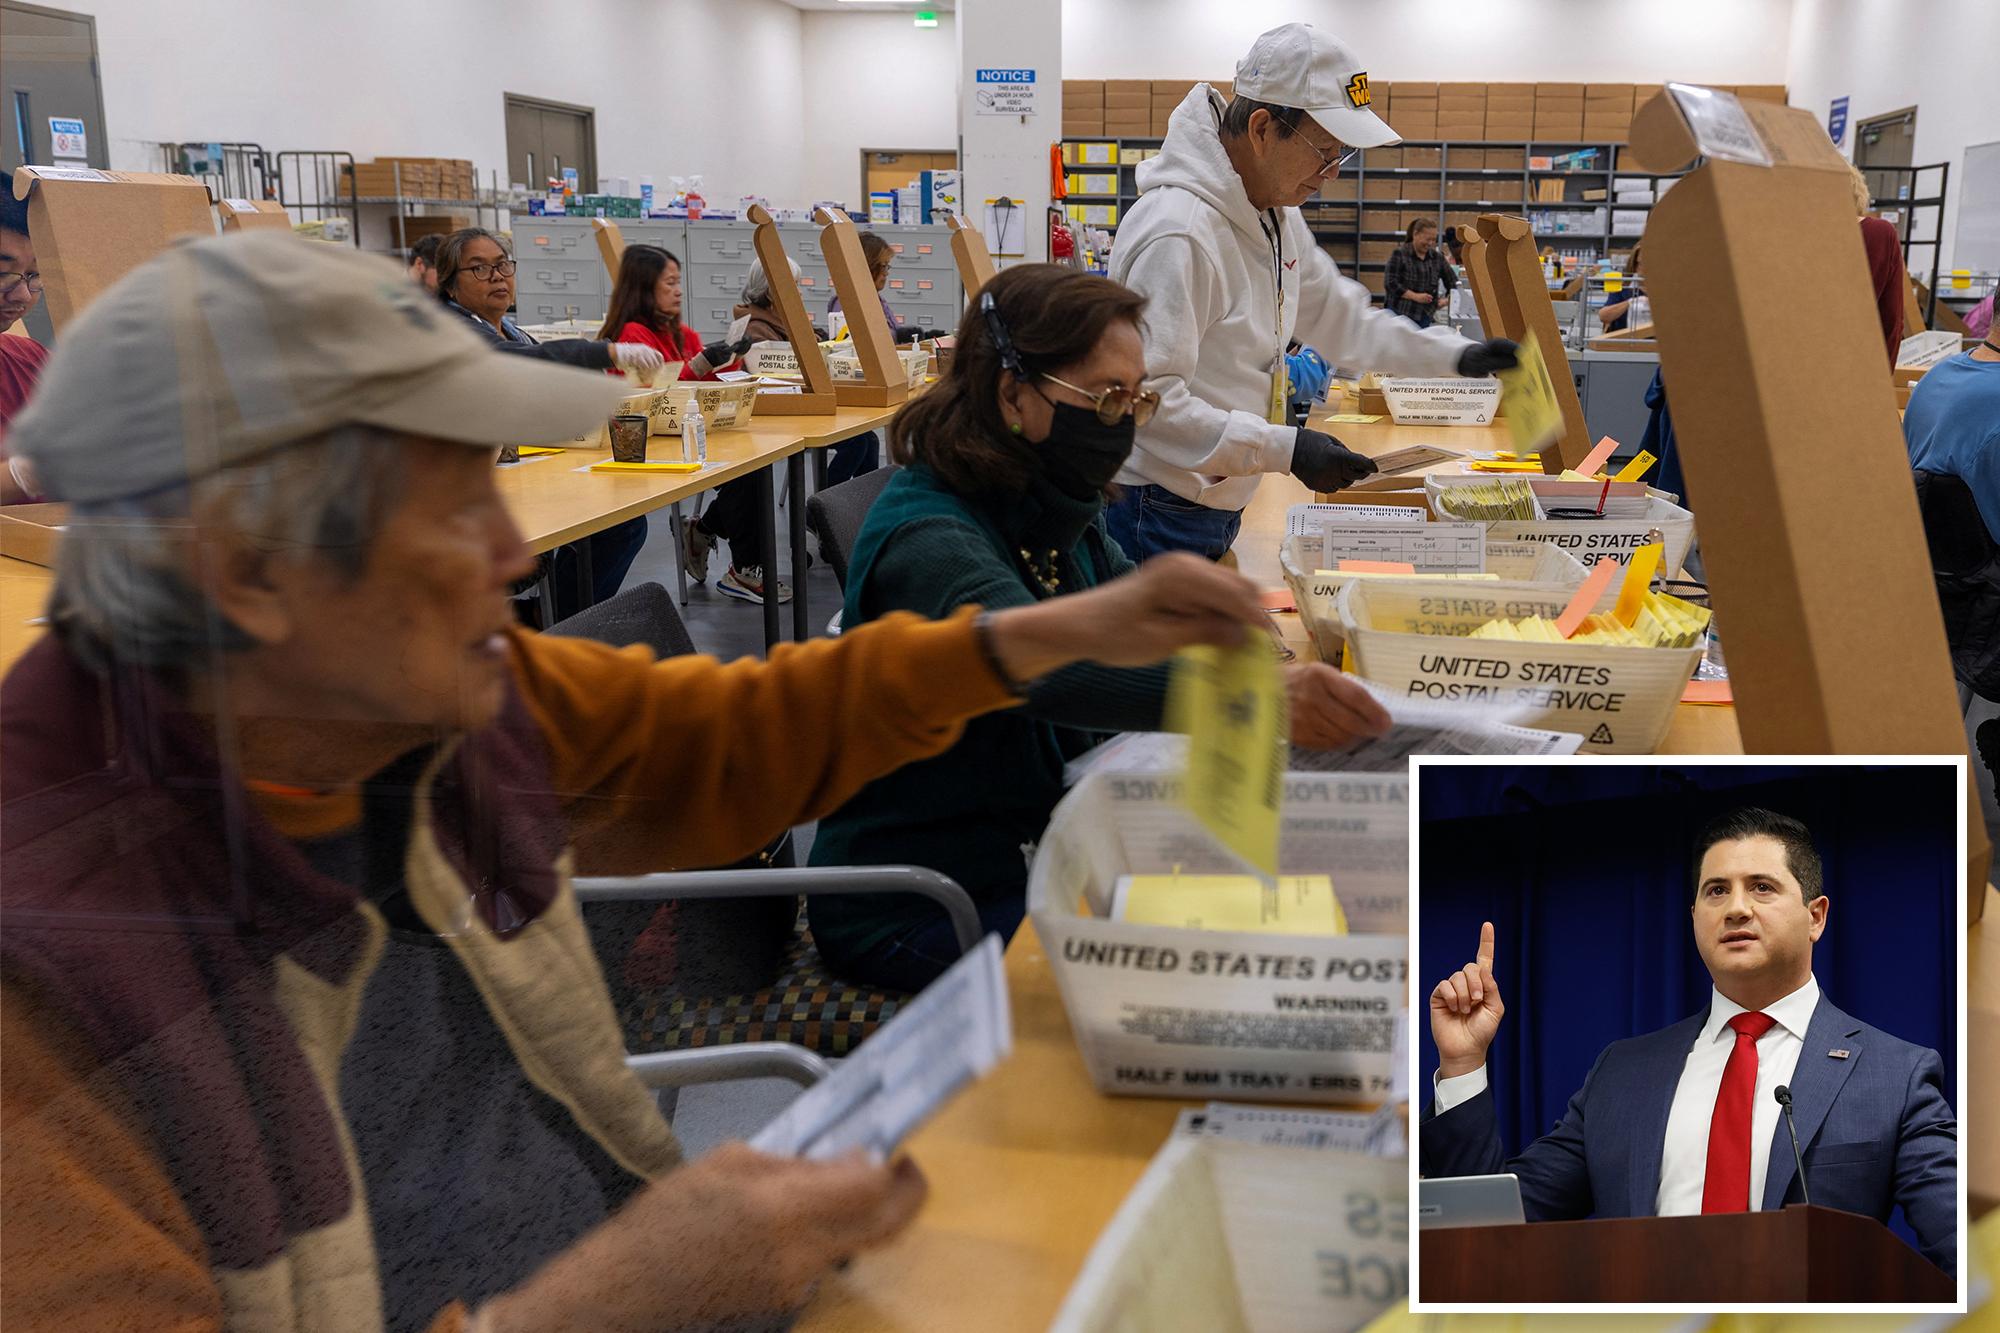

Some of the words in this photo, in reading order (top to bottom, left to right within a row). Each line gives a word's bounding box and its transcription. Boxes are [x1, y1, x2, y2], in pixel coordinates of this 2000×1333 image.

[980, 71, 1031, 81] NOTICE
[1350, 89, 1371, 106] WA
[1586, 534, 1652, 548] STATES
[1420, 654, 1510, 679] UNITED
[1518, 662, 1611, 686] STATES
[1517, 688, 1625, 712] SERVICE
[1063, 938, 1179, 974] UNITED
[1189, 950, 1315, 981] STATES
[1324, 957, 1408, 984] POST
[1274, 994, 1390, 1014] WARNING
[1115, 1067, 1177, 1087] HALF
[1183, 1070, 1220, 1086] MM
[1229, 1071, 1289, 1089] TRAY
[1308, 1072, 1363, 1092] EIRS
